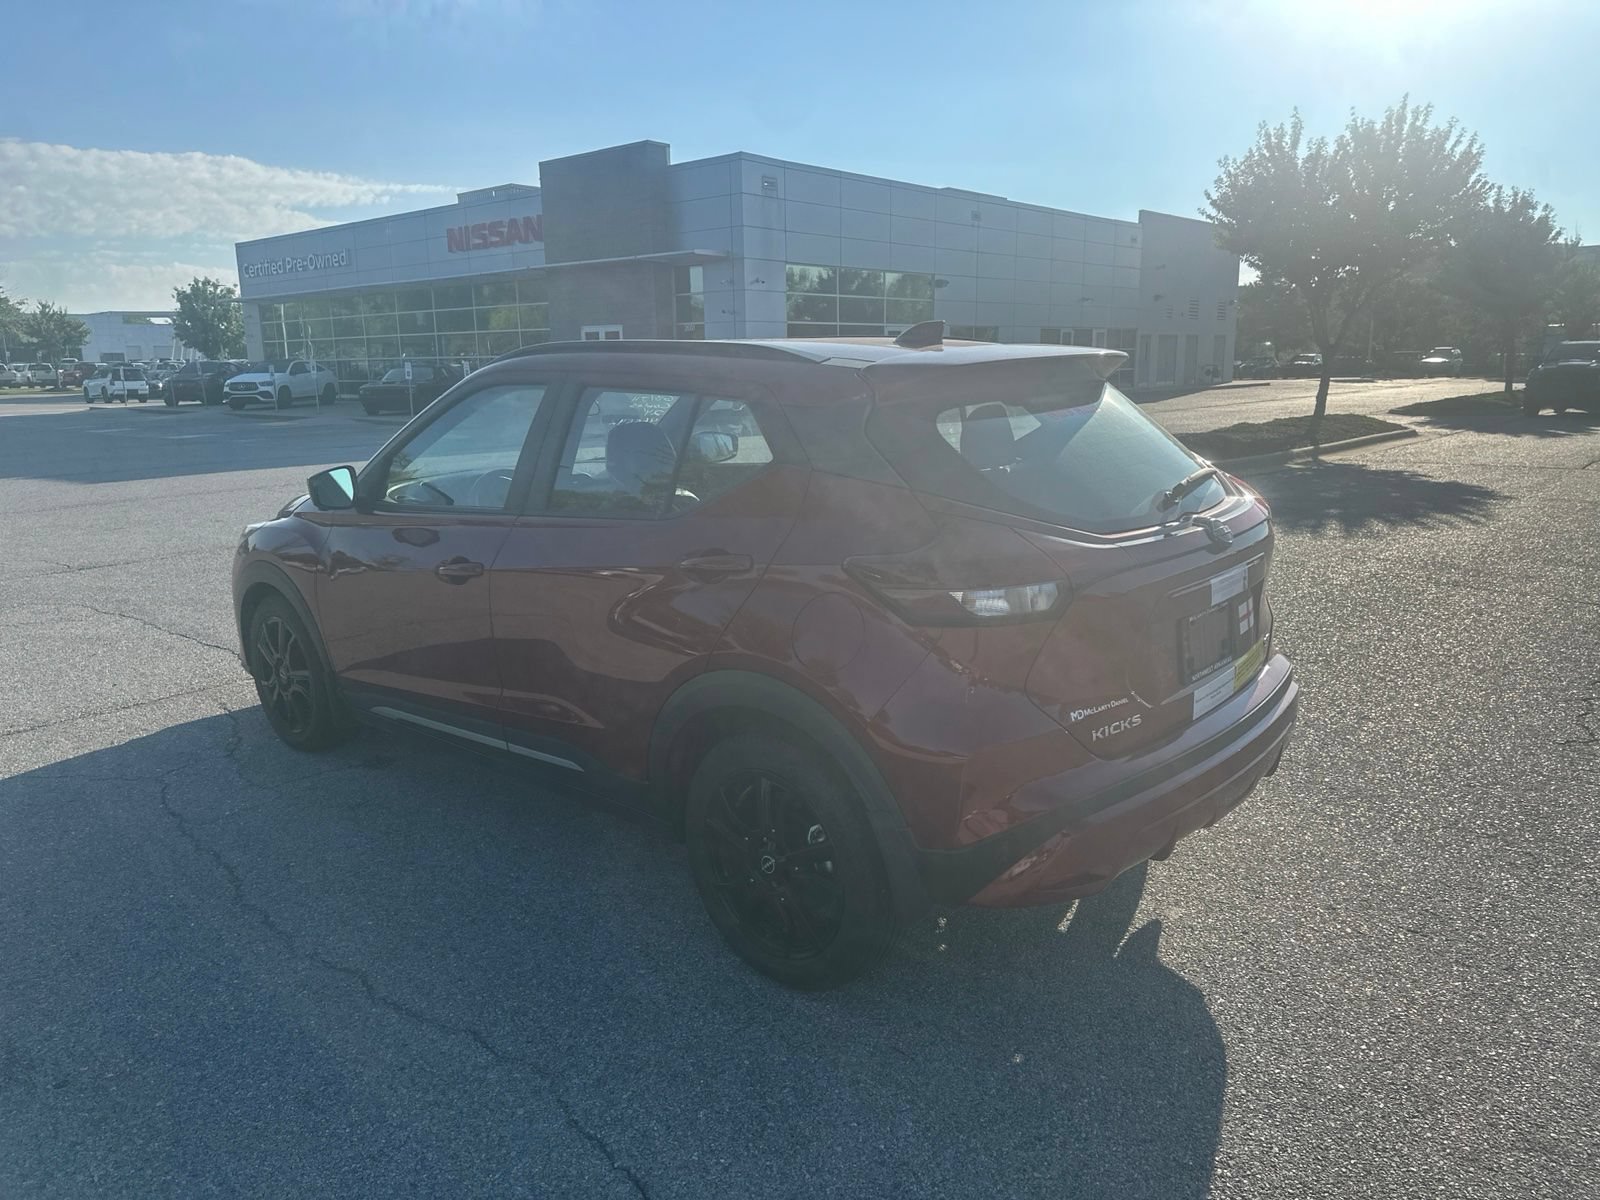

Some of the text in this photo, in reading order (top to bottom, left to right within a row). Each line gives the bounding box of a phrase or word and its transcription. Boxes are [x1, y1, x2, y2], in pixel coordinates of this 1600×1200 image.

[447, 214, 544, 253] NISSAN
[242, 247, 347, 279] Certified Pre-Owned
[1091, 714, 1143, 742] KICKS
